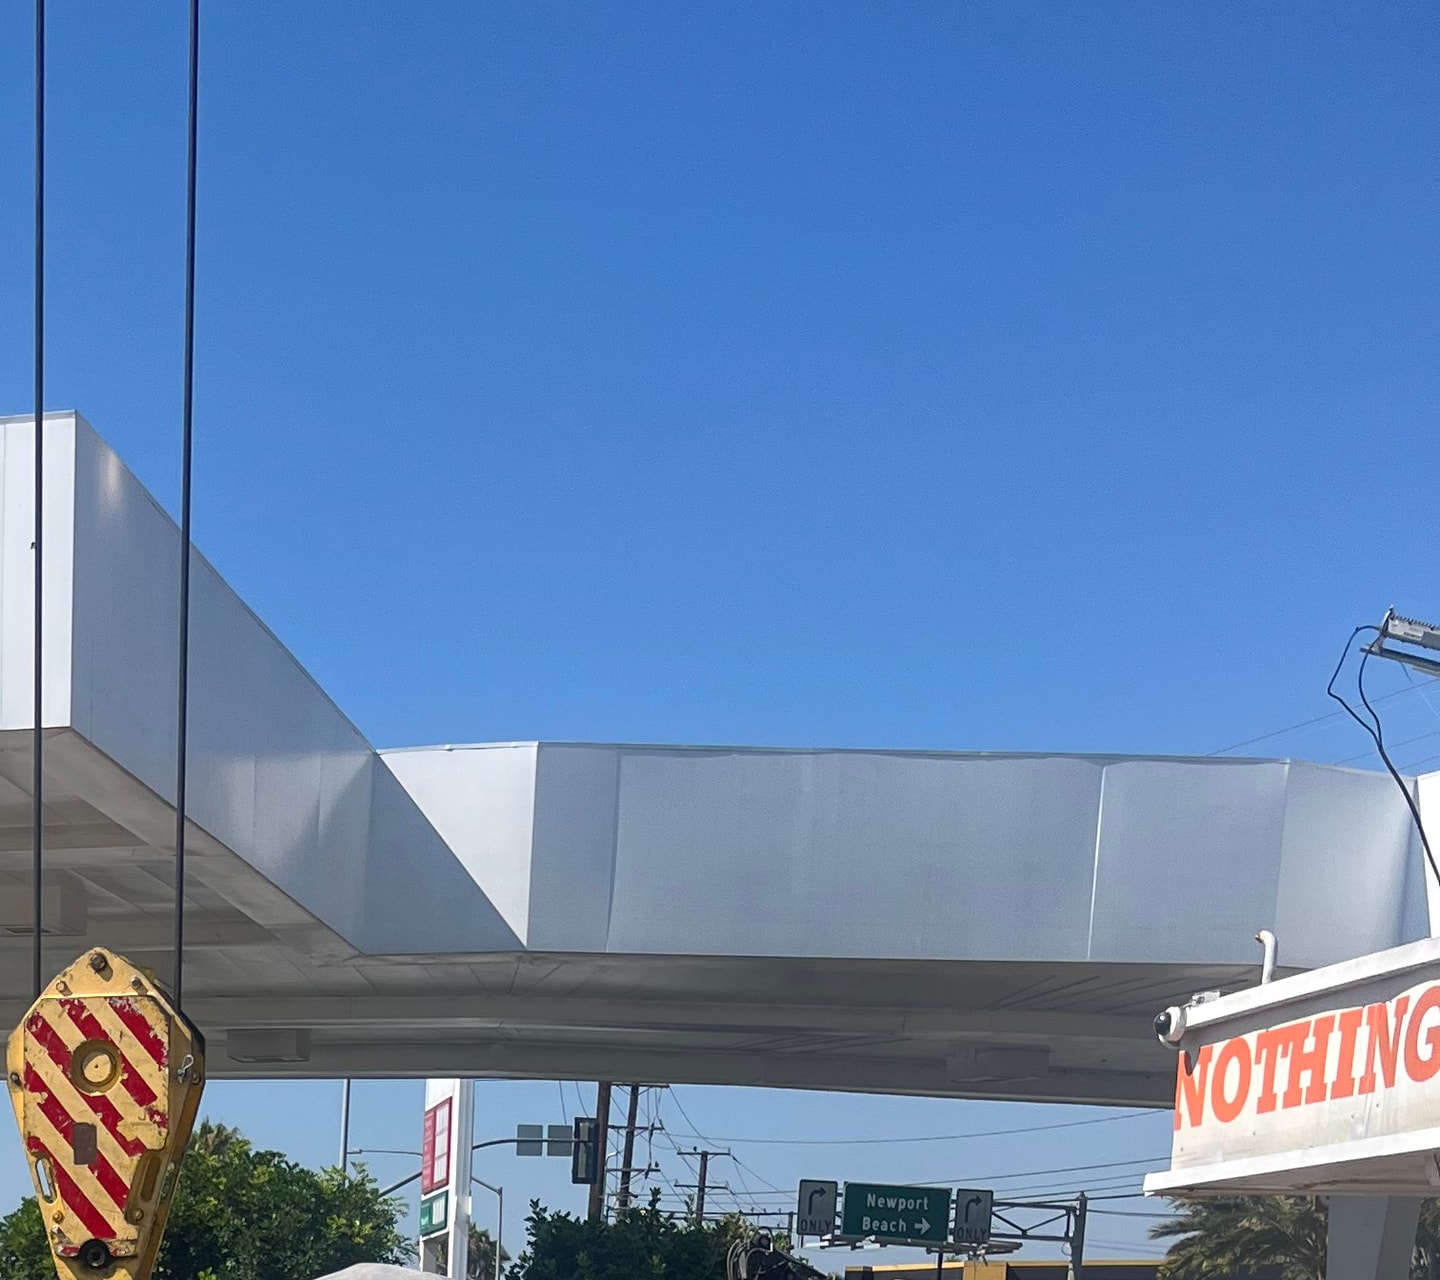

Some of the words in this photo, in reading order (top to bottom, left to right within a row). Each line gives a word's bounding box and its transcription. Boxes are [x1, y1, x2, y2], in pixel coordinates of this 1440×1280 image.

[1174, 985, 1440, 1131] NOTHING
[867, 1193, 929, 1212] Newport
[800, 1219, 832, 1232] ONLY
[862, 1217, 907, 1232] Beach
[956, 1227, 988, 1240] ONLY
